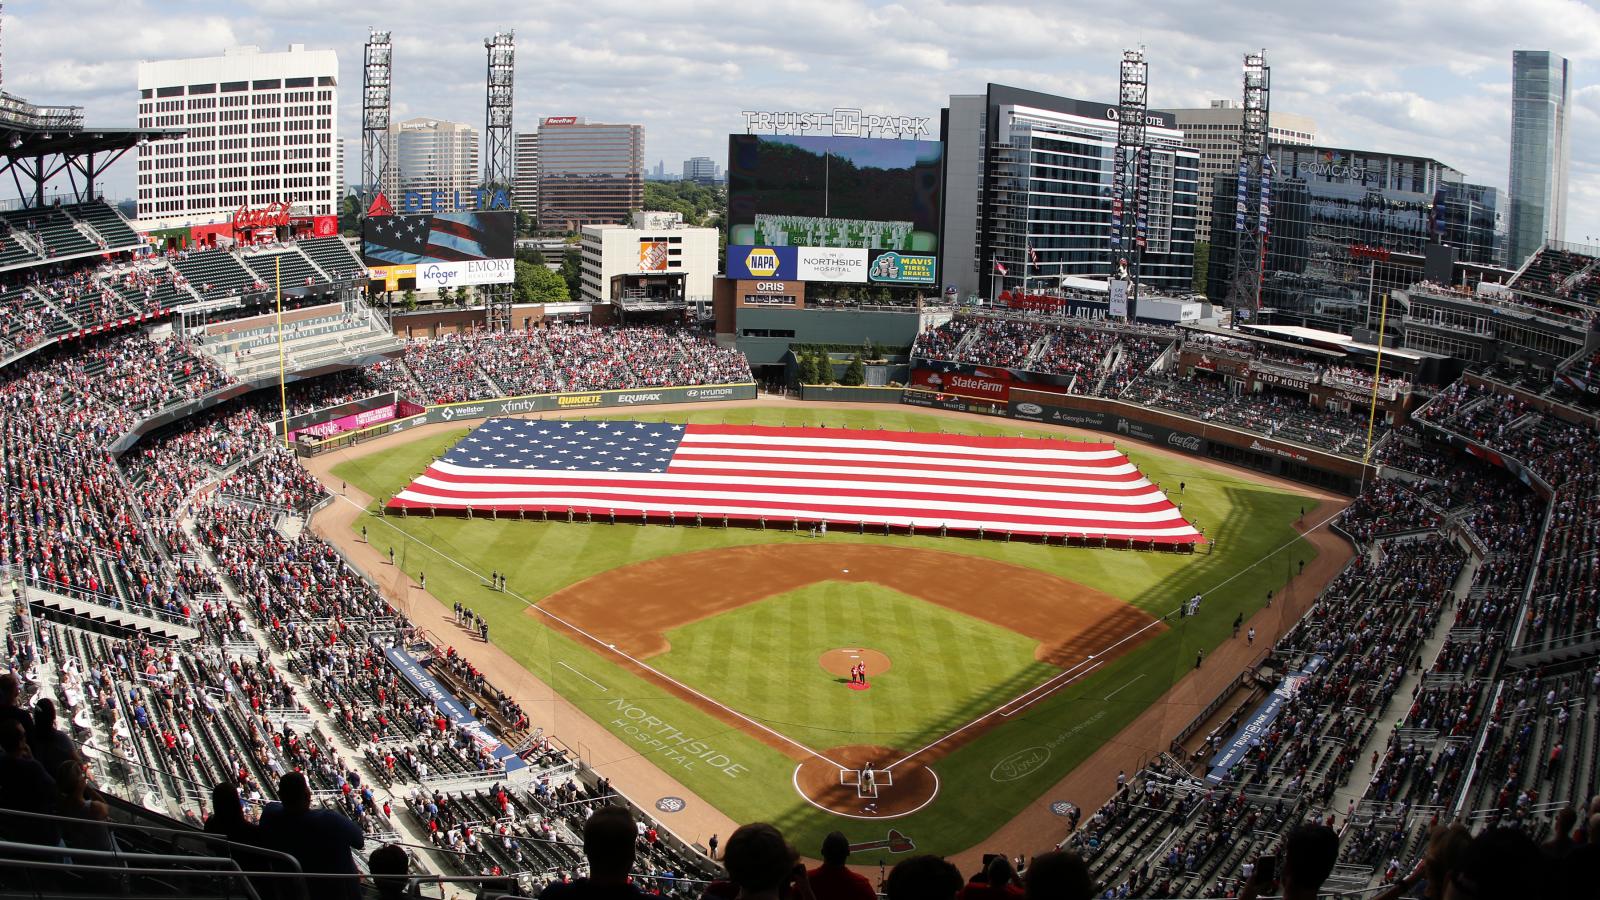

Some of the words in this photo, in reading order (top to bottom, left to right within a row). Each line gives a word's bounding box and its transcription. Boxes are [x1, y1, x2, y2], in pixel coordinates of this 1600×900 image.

[741, 111, 827, 130] TRUIST
[867, 114, 930, 136] PARK
[1299, 162, 1367, 180] COMCAST
[404, 190, 511, 212] DELTA
[234, 201, 293, 229] Coca-Cola
[639, 241, 667, 270] HOME
[751, 255, 775, 269] NAPA
[803, 258, 862, 267] NORTHSIDE
[901, 258, 932, 266] MAVIS
[424, 265, 458, 284] Kroger
[468, 260, 511, 273] EMORY
[757, 282, 784, 291] ORIS
[1257, 372, 1279, 383] CHOP
[1281, 378, 1310, 390] HOUSE
[501, 400, 535, 413] xfinity
[558, 395, 602, 405] QUIKRETE
[618, 393, 661, 404] EQUIFAX
[456, 406, 484, 414] Wellstar
[1062, 413, 1085, 423] Georgia
[1085, 417, 1103, 425] Power
[1167, 432, 1200, 450] Coca-Cola
[407, 666, 427, 681] TRUIST
[607, 697, 749, 778] NORTHSIDE
[1233, 731, 1253, 748] TRUIST
[1253, 713, 1266, 727] PARK
[611, 719, 696, 770] HOSPITAL
[1002, 752, 1044, 777] Ford
